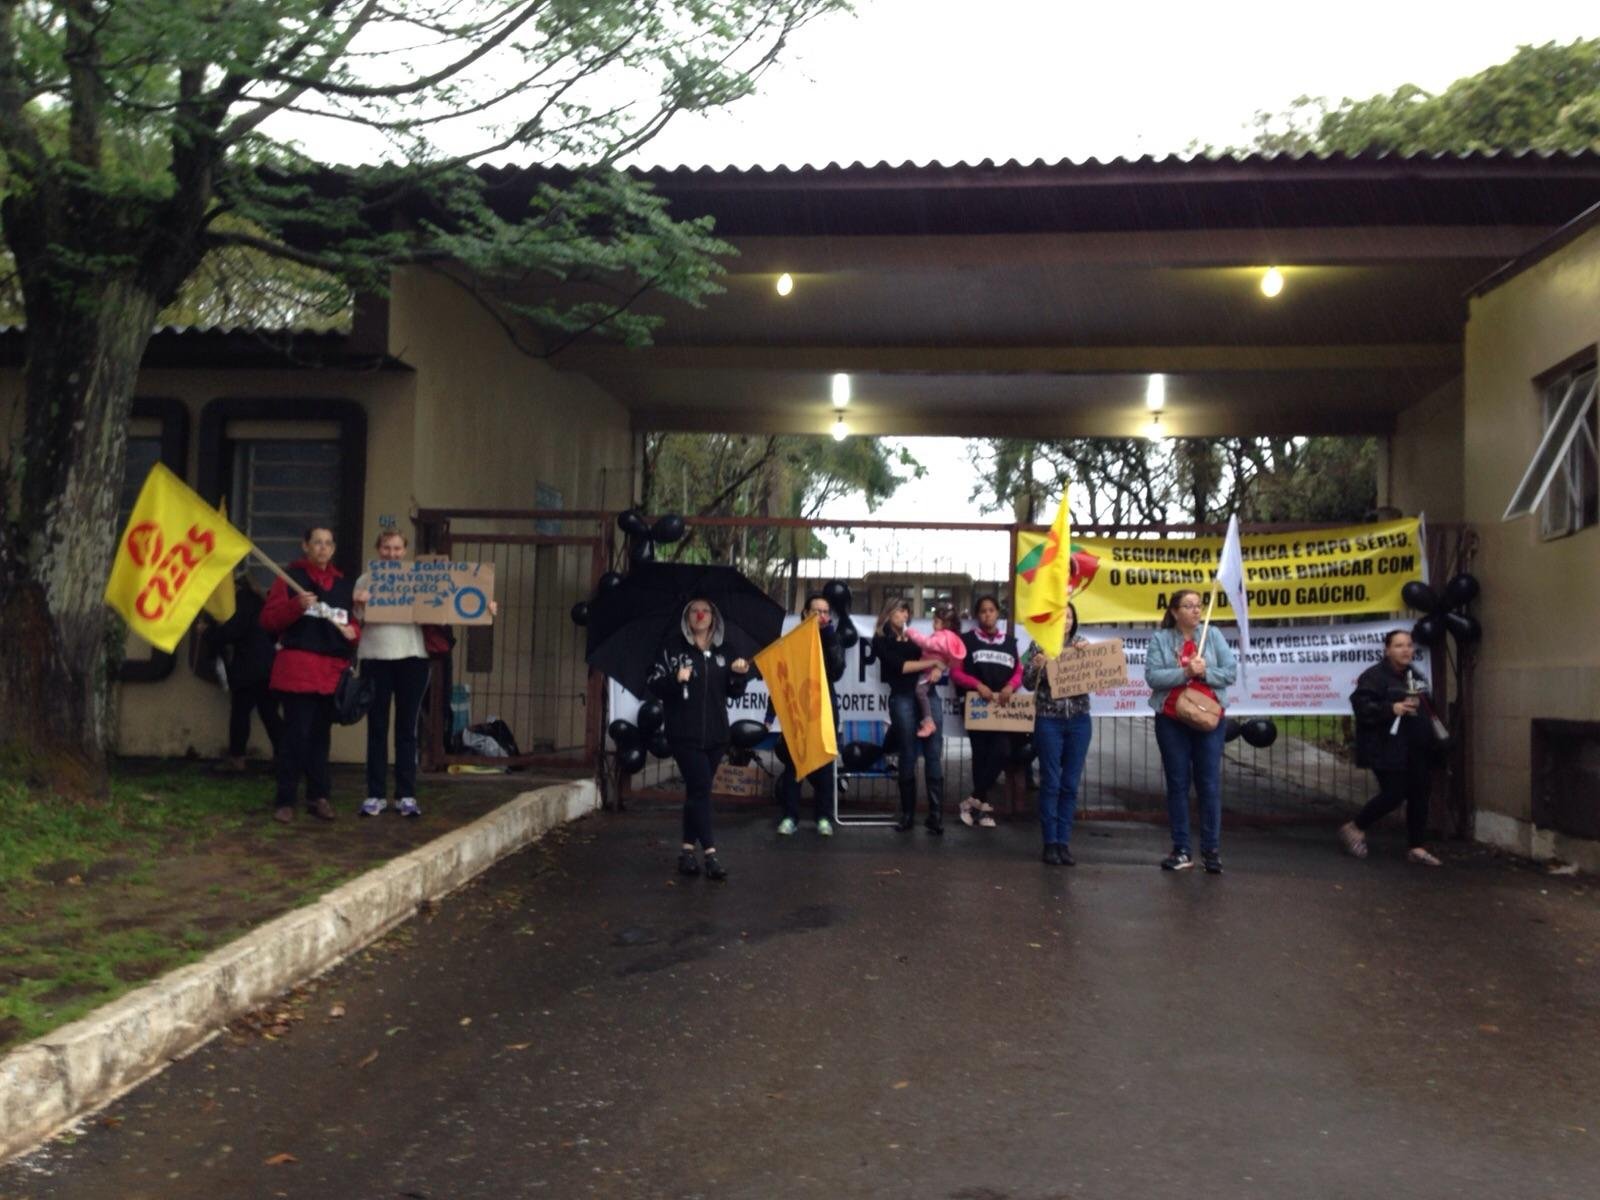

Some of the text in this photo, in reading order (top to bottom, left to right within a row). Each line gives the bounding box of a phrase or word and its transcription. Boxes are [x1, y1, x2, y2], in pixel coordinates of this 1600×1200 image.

[1112, 547, 1212, 565] SEGURANÇA
[1293, 539, 1303, 559] É
[1306, 538, 1352, 557] PAPO
[1356, 532, 1413, 551] SÉRIO.
[1110, 569, 1121, 586] O
[1126, 568, 1204, 585] GOVERNO
[1247, 564, 1292, 581] PODE
[1296, 558, 1373, 580] BRINCAR
[1378, 554, 1415, 575] COM
[1246, 587, 1292, 607] POVO
[1295, 583, 1370, 605] GAÚCHO.
[1276, 632, 1329, 649] PÚBLICA
[1332, 633, 1347, 646] DE
[1280, 651, 1296, 664] DE
[1298, 650, 1329, 664] SEUS
